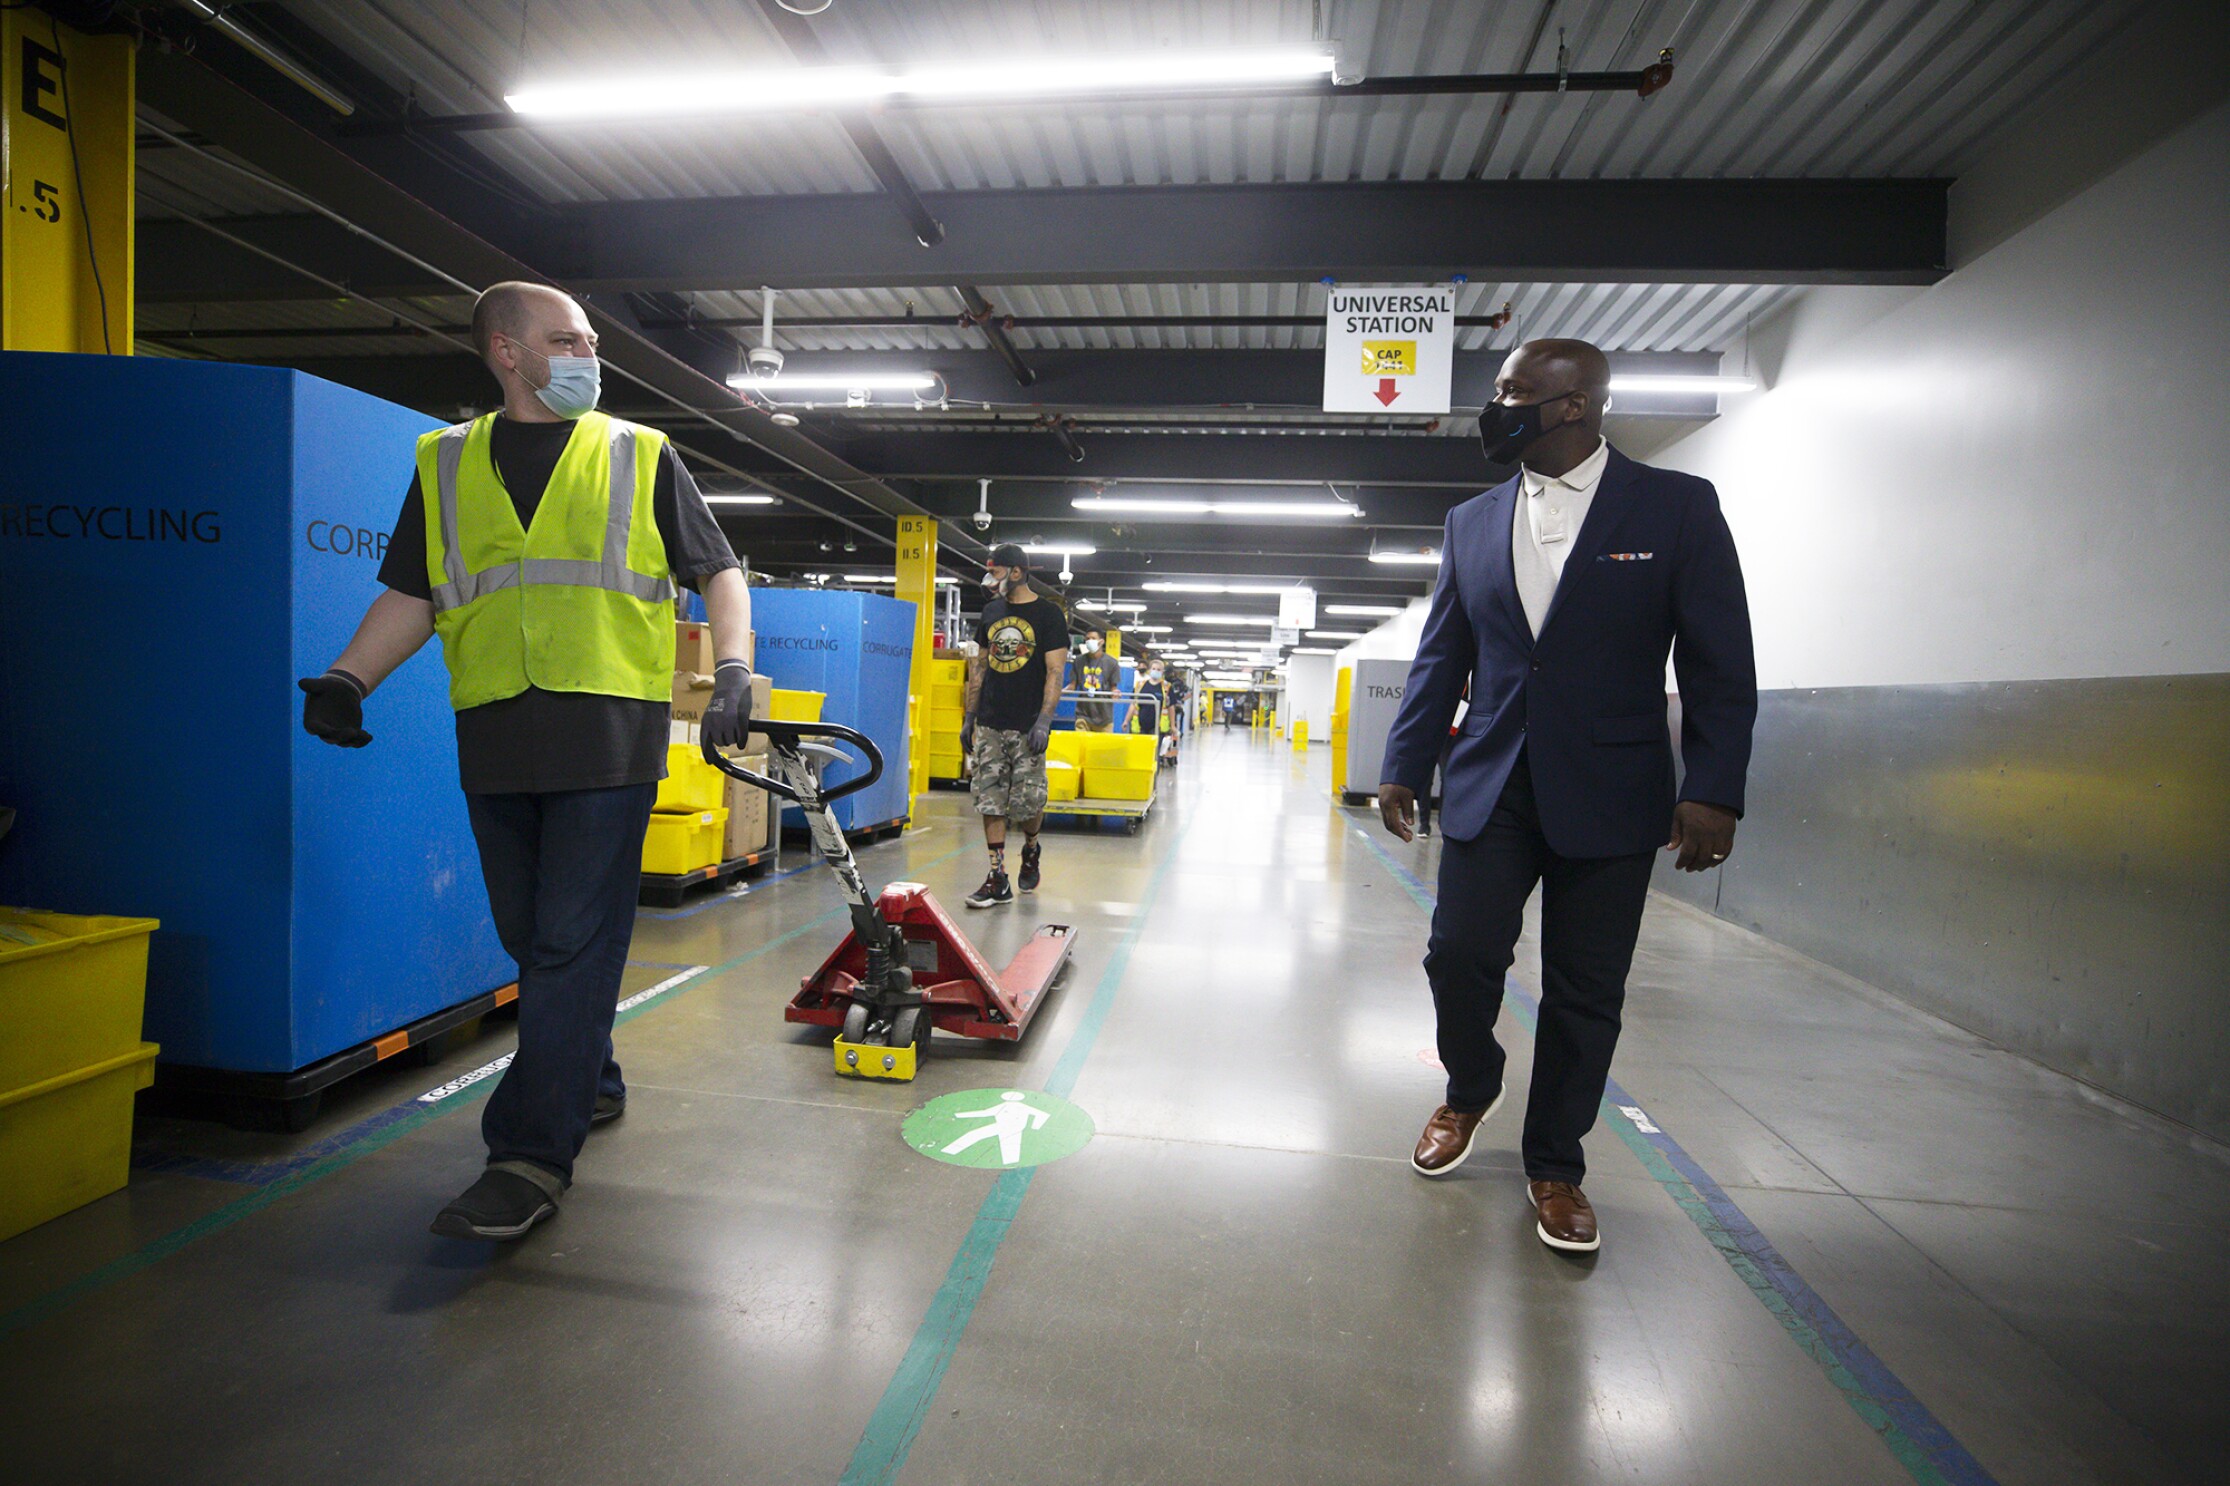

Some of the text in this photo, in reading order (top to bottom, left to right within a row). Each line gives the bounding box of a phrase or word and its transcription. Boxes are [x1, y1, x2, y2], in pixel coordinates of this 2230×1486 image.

[22, 35, 67, 132] E
[1333, 295, 1451, 314] UNIVERSAL
[1346, 316, 1434, 334] STATION
[1377, 349, 1402, 360] CAP
[1, 503, 222, 544] RECYCLING
[769, 636, 839, 651] RECYCLING
